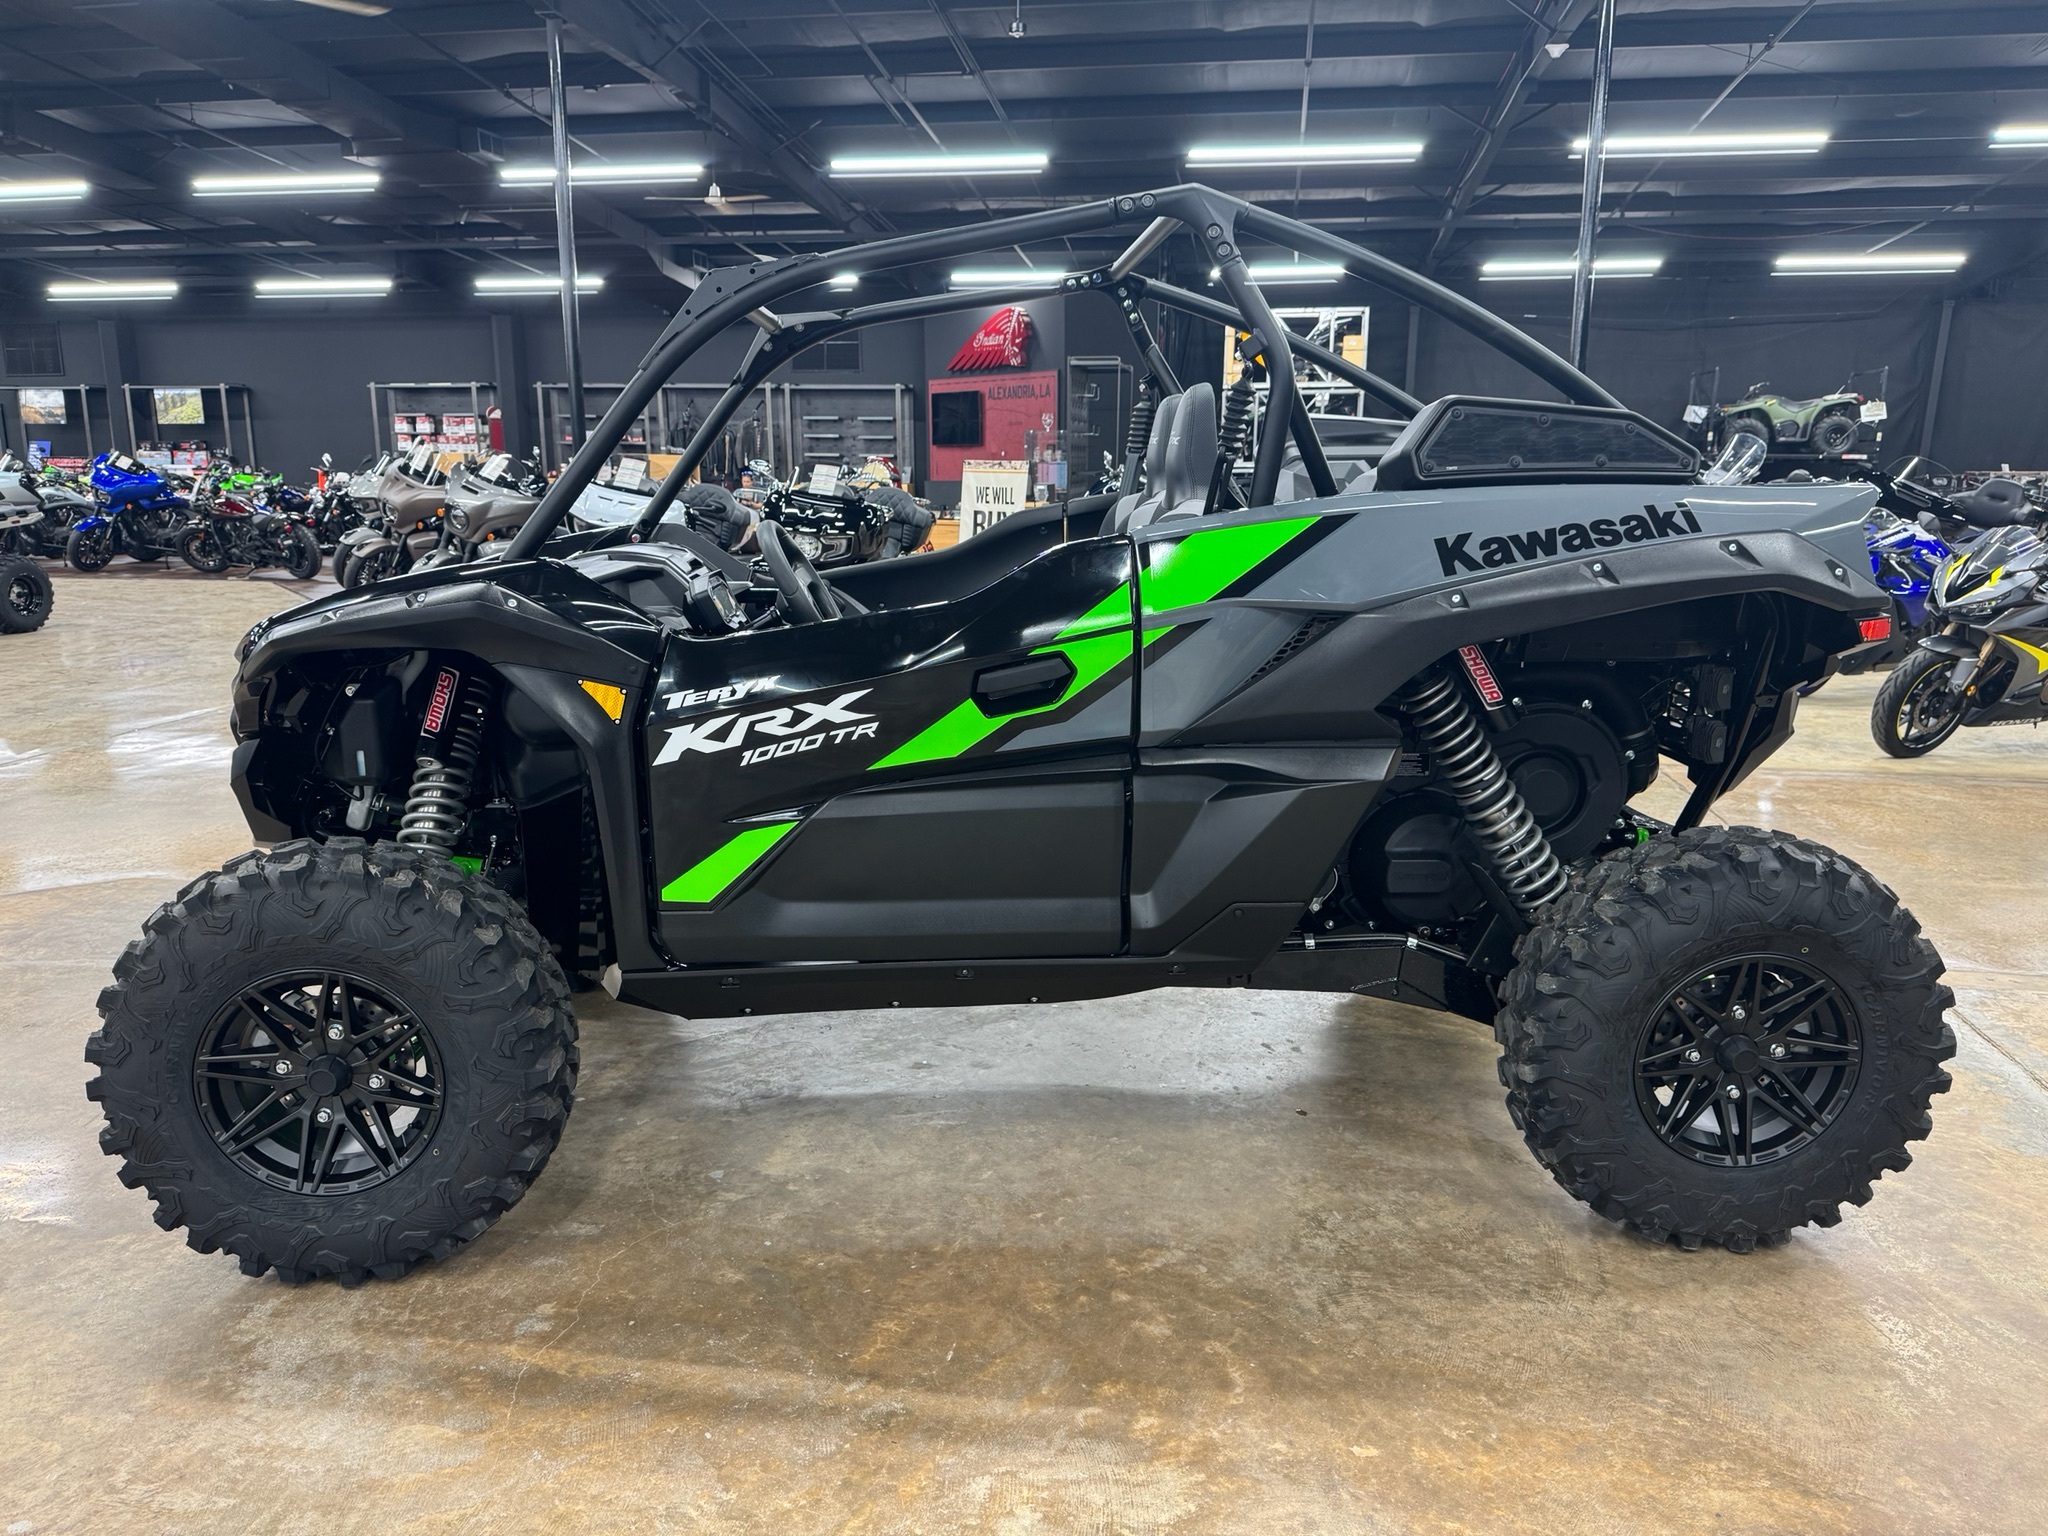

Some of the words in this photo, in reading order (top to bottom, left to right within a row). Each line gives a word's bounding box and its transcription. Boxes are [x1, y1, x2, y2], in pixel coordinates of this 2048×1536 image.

[973, 330, 1004, 348] Indian
[987, 385, 1039, 400] ALEXANDRIA,
[1040, 383, 1051, 398] LA
[976, 486, 990, 504] WE
[992, 487, 1015, 505] WILL
[1434, 501, 1703, 578] Kawasaki
[424, 671, 454, 733] SHOWA
[1459, 645, 1504, 704] SHOWA
[651, 687, 877, 767] KRX
[1856, 988, 1889, 1117] CARNIVORE
